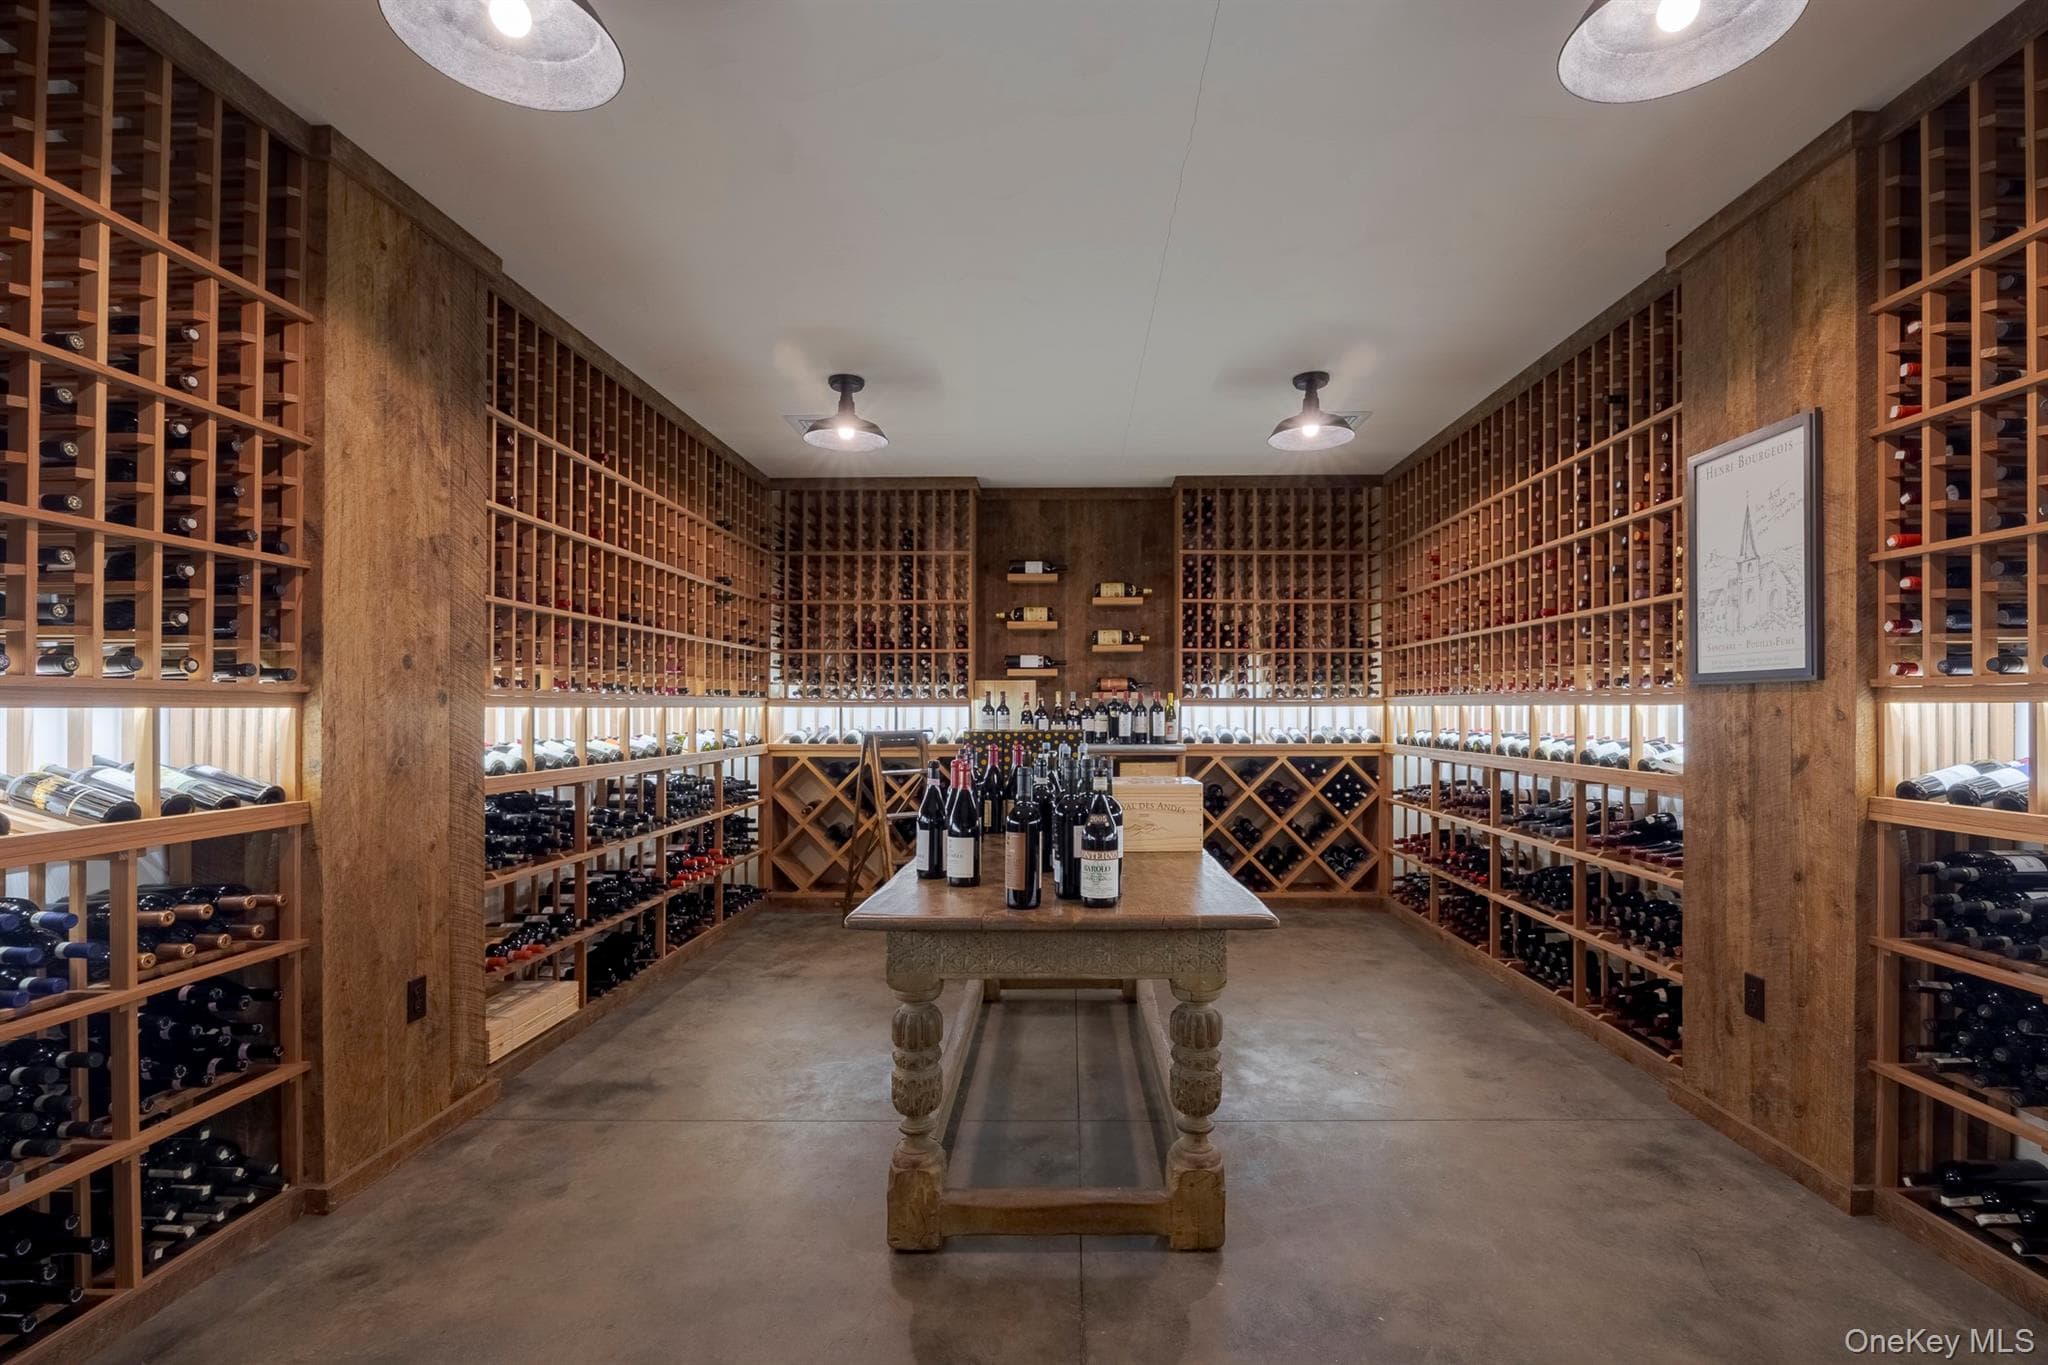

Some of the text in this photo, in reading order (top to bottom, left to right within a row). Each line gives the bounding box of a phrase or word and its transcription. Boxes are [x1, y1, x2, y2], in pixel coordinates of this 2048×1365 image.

[1706, 441, 1793, 481] HENRI BOURGEOIS
[1138, 802, 1155, 810] DES
[1157, 801, 1186, 814] ANDES
[1083, 862, 1111, 873] BAROLO
